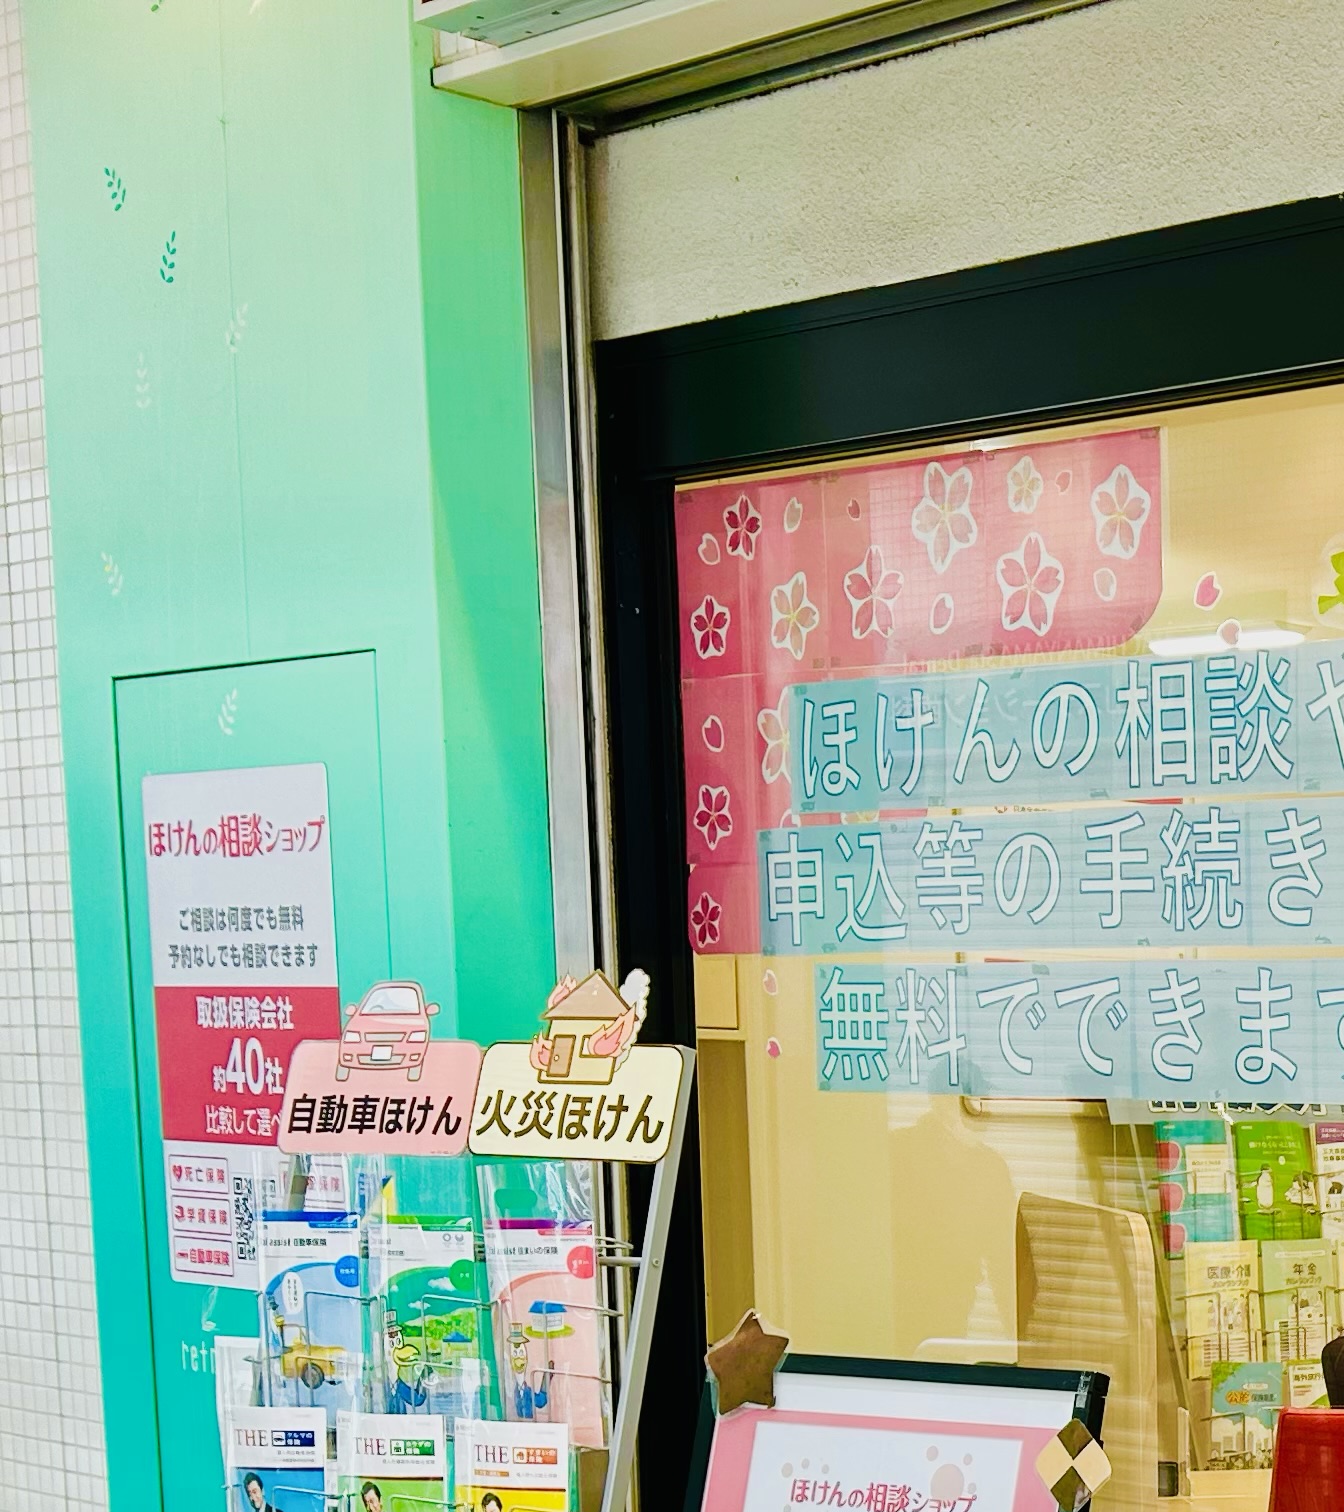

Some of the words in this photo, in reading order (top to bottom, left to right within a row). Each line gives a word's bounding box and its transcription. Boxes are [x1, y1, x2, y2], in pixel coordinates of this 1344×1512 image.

[147, 814, 326, 859] ほけんの相談ショップ
[177, 904, 305, 932] ご相談は何度でも無料
[168, 942, 319, 969] 予約なしでも相談できます
[196, 995, 295, 1032] 取扱保険会社
[213, 1036, 284, 1096] 約40社
[288, 1093, 463, 1137] 自動車ほけん
[475, 1088, 665, 1143] 火災ほけん
[233, 1429, 267, 1447] THE
[354, 1437, 386, 1456] THE
[475, 1444, 509, 1463] THE
